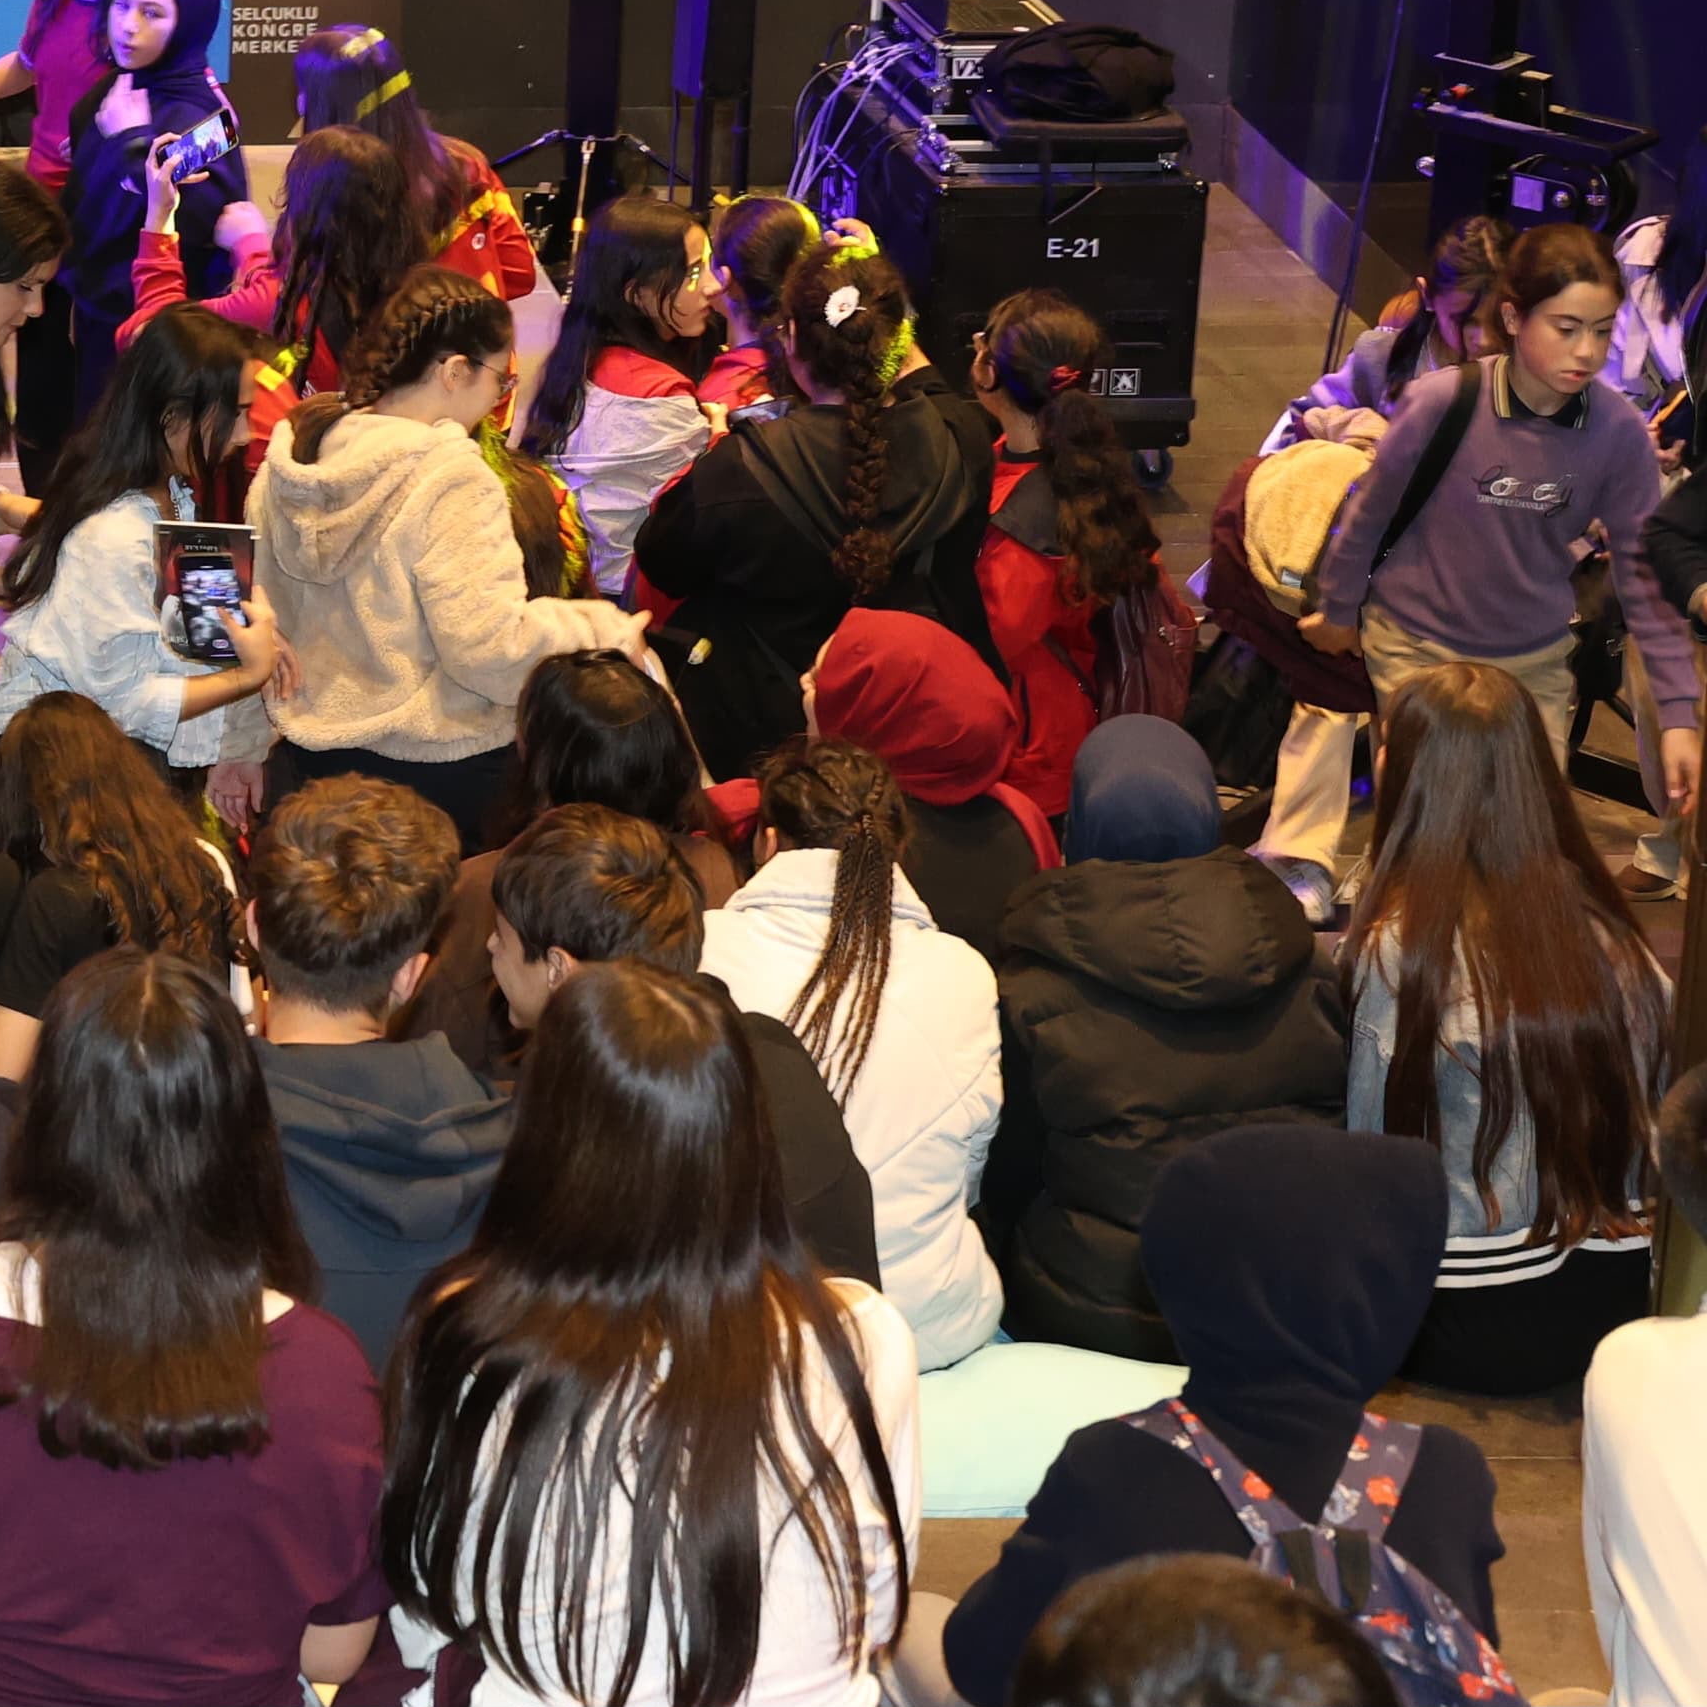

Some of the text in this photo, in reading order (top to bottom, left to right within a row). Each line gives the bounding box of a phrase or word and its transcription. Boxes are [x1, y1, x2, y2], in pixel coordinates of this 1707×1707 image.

[232, 6, 319, 23] SELÇUKLU
[232, 23, 319, 38] KONGRE
[232, 39, 305, 54] MERKE
[1047, 238, 1100, 258] E-21
